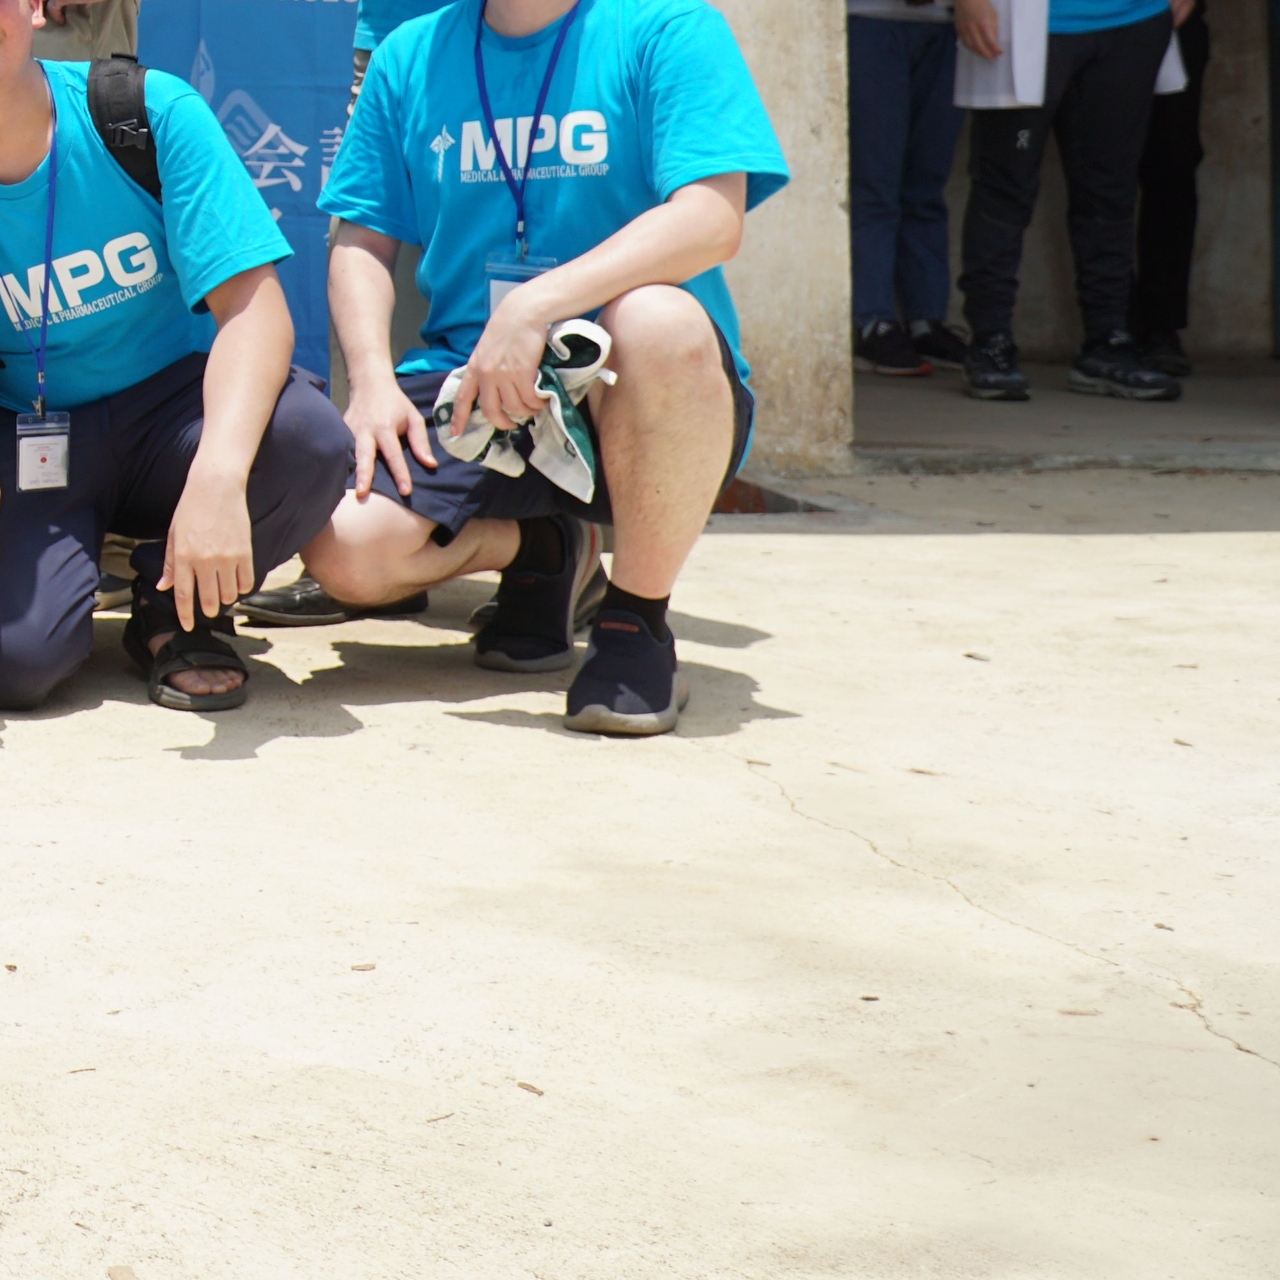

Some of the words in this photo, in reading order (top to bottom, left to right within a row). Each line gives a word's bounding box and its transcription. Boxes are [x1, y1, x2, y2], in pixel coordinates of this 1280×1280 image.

[460, 109, 609, 171] MPG
[578, 163, 609, 177] GROUP
[59, 286, 137, 322] PHARMACEUTICAL
